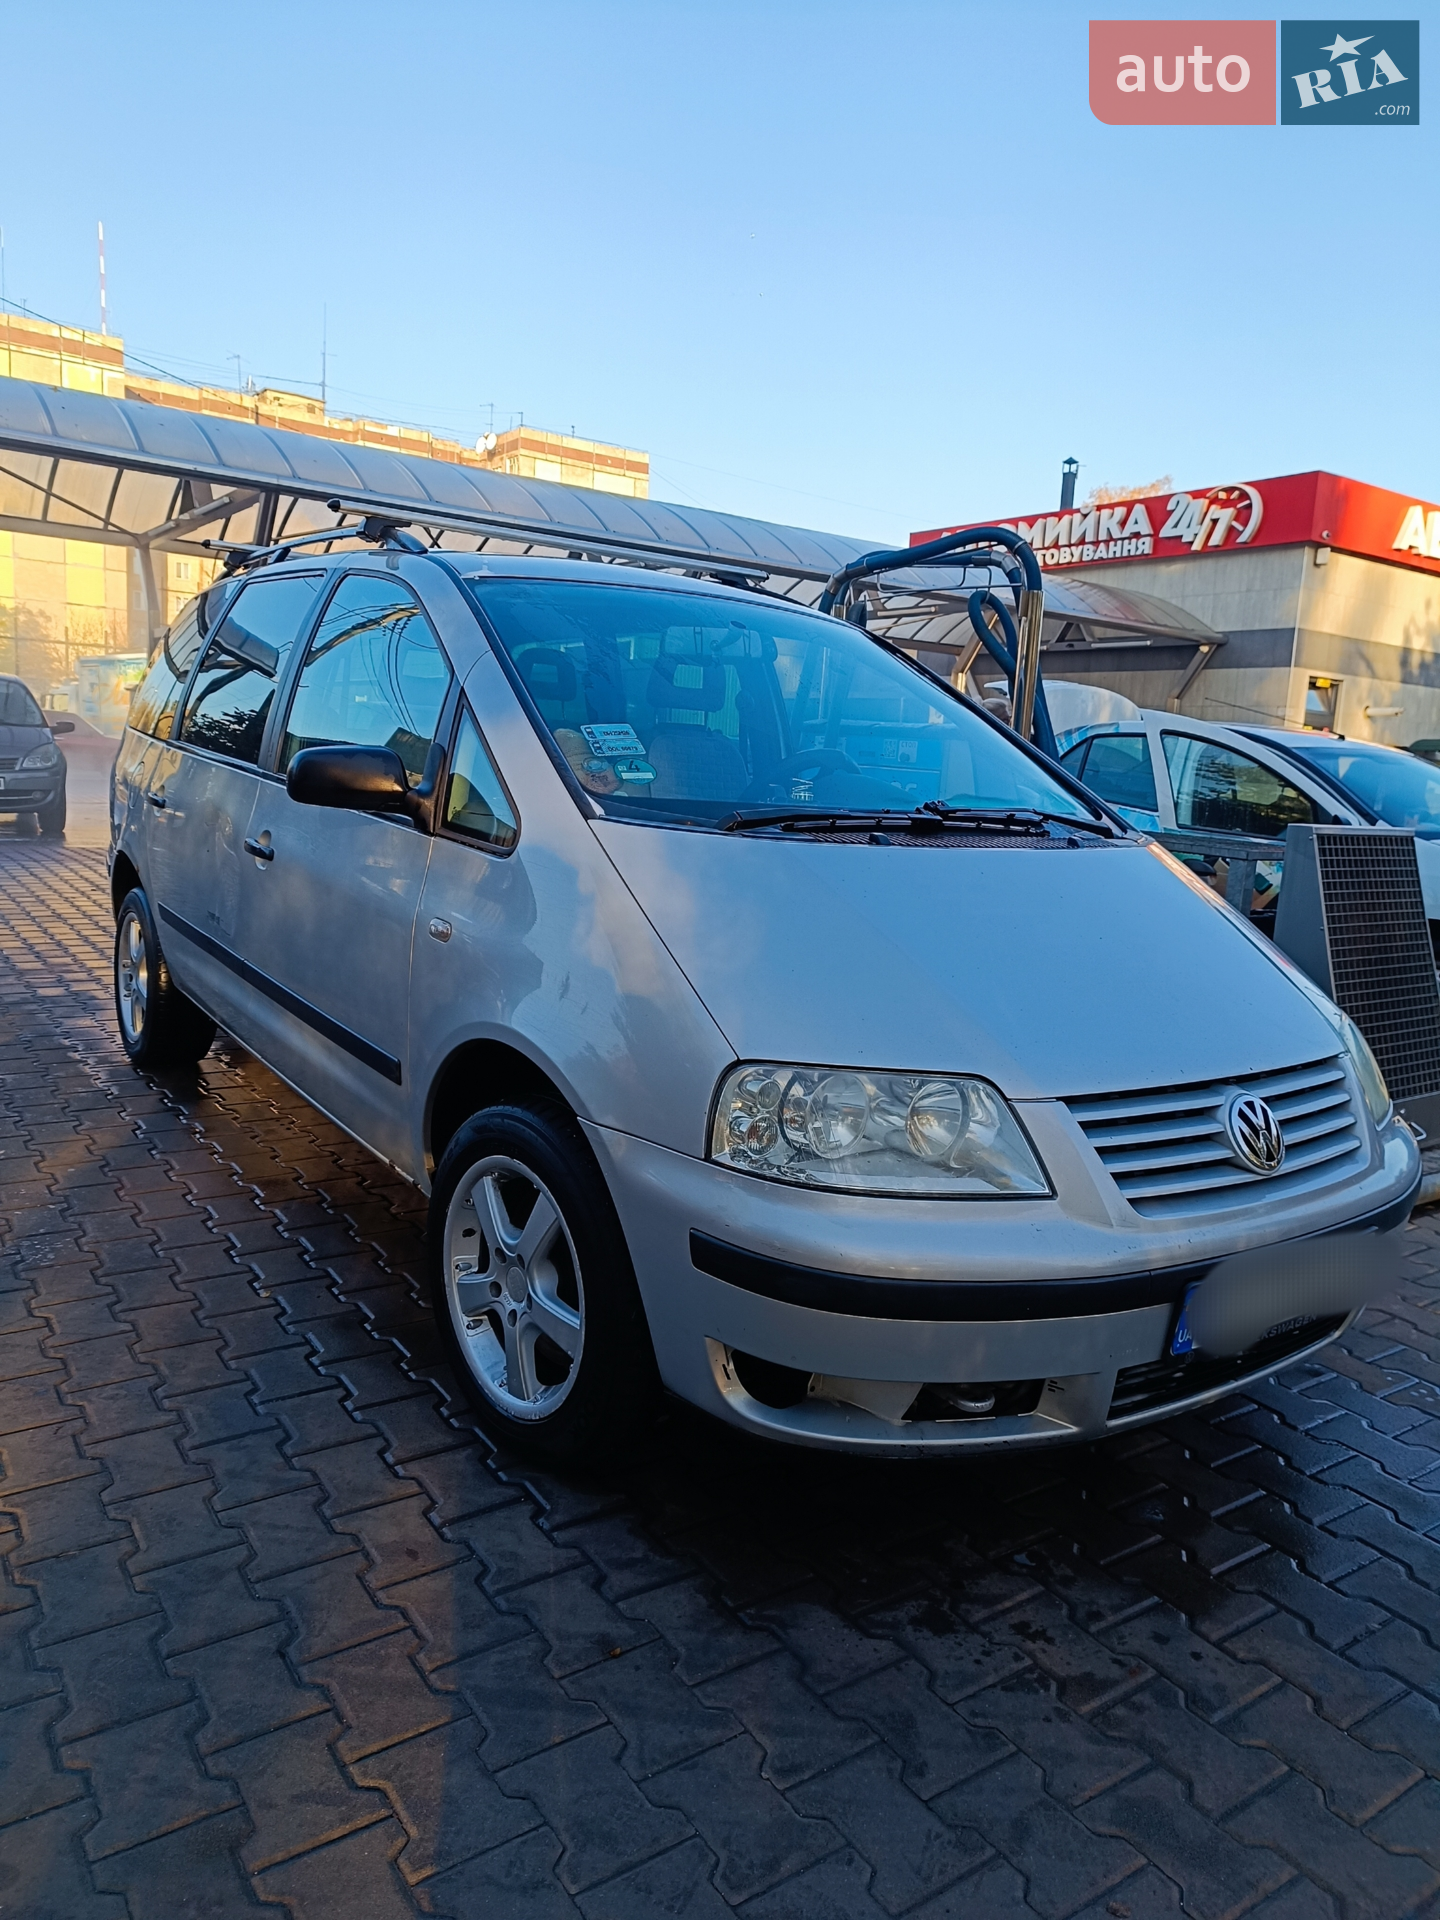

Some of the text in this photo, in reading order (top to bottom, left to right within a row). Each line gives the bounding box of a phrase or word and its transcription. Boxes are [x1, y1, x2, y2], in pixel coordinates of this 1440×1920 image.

[940, 493, 1238, 554] МИЙКА 24/7
[1034, 536, 1153, 567] ГОВУВАННЯ
[629, 760, 640, 772] 4
[1178, 1328, 1193, 1343] UA
[1257, 1313, 1318, 1340] KSWAGEN
